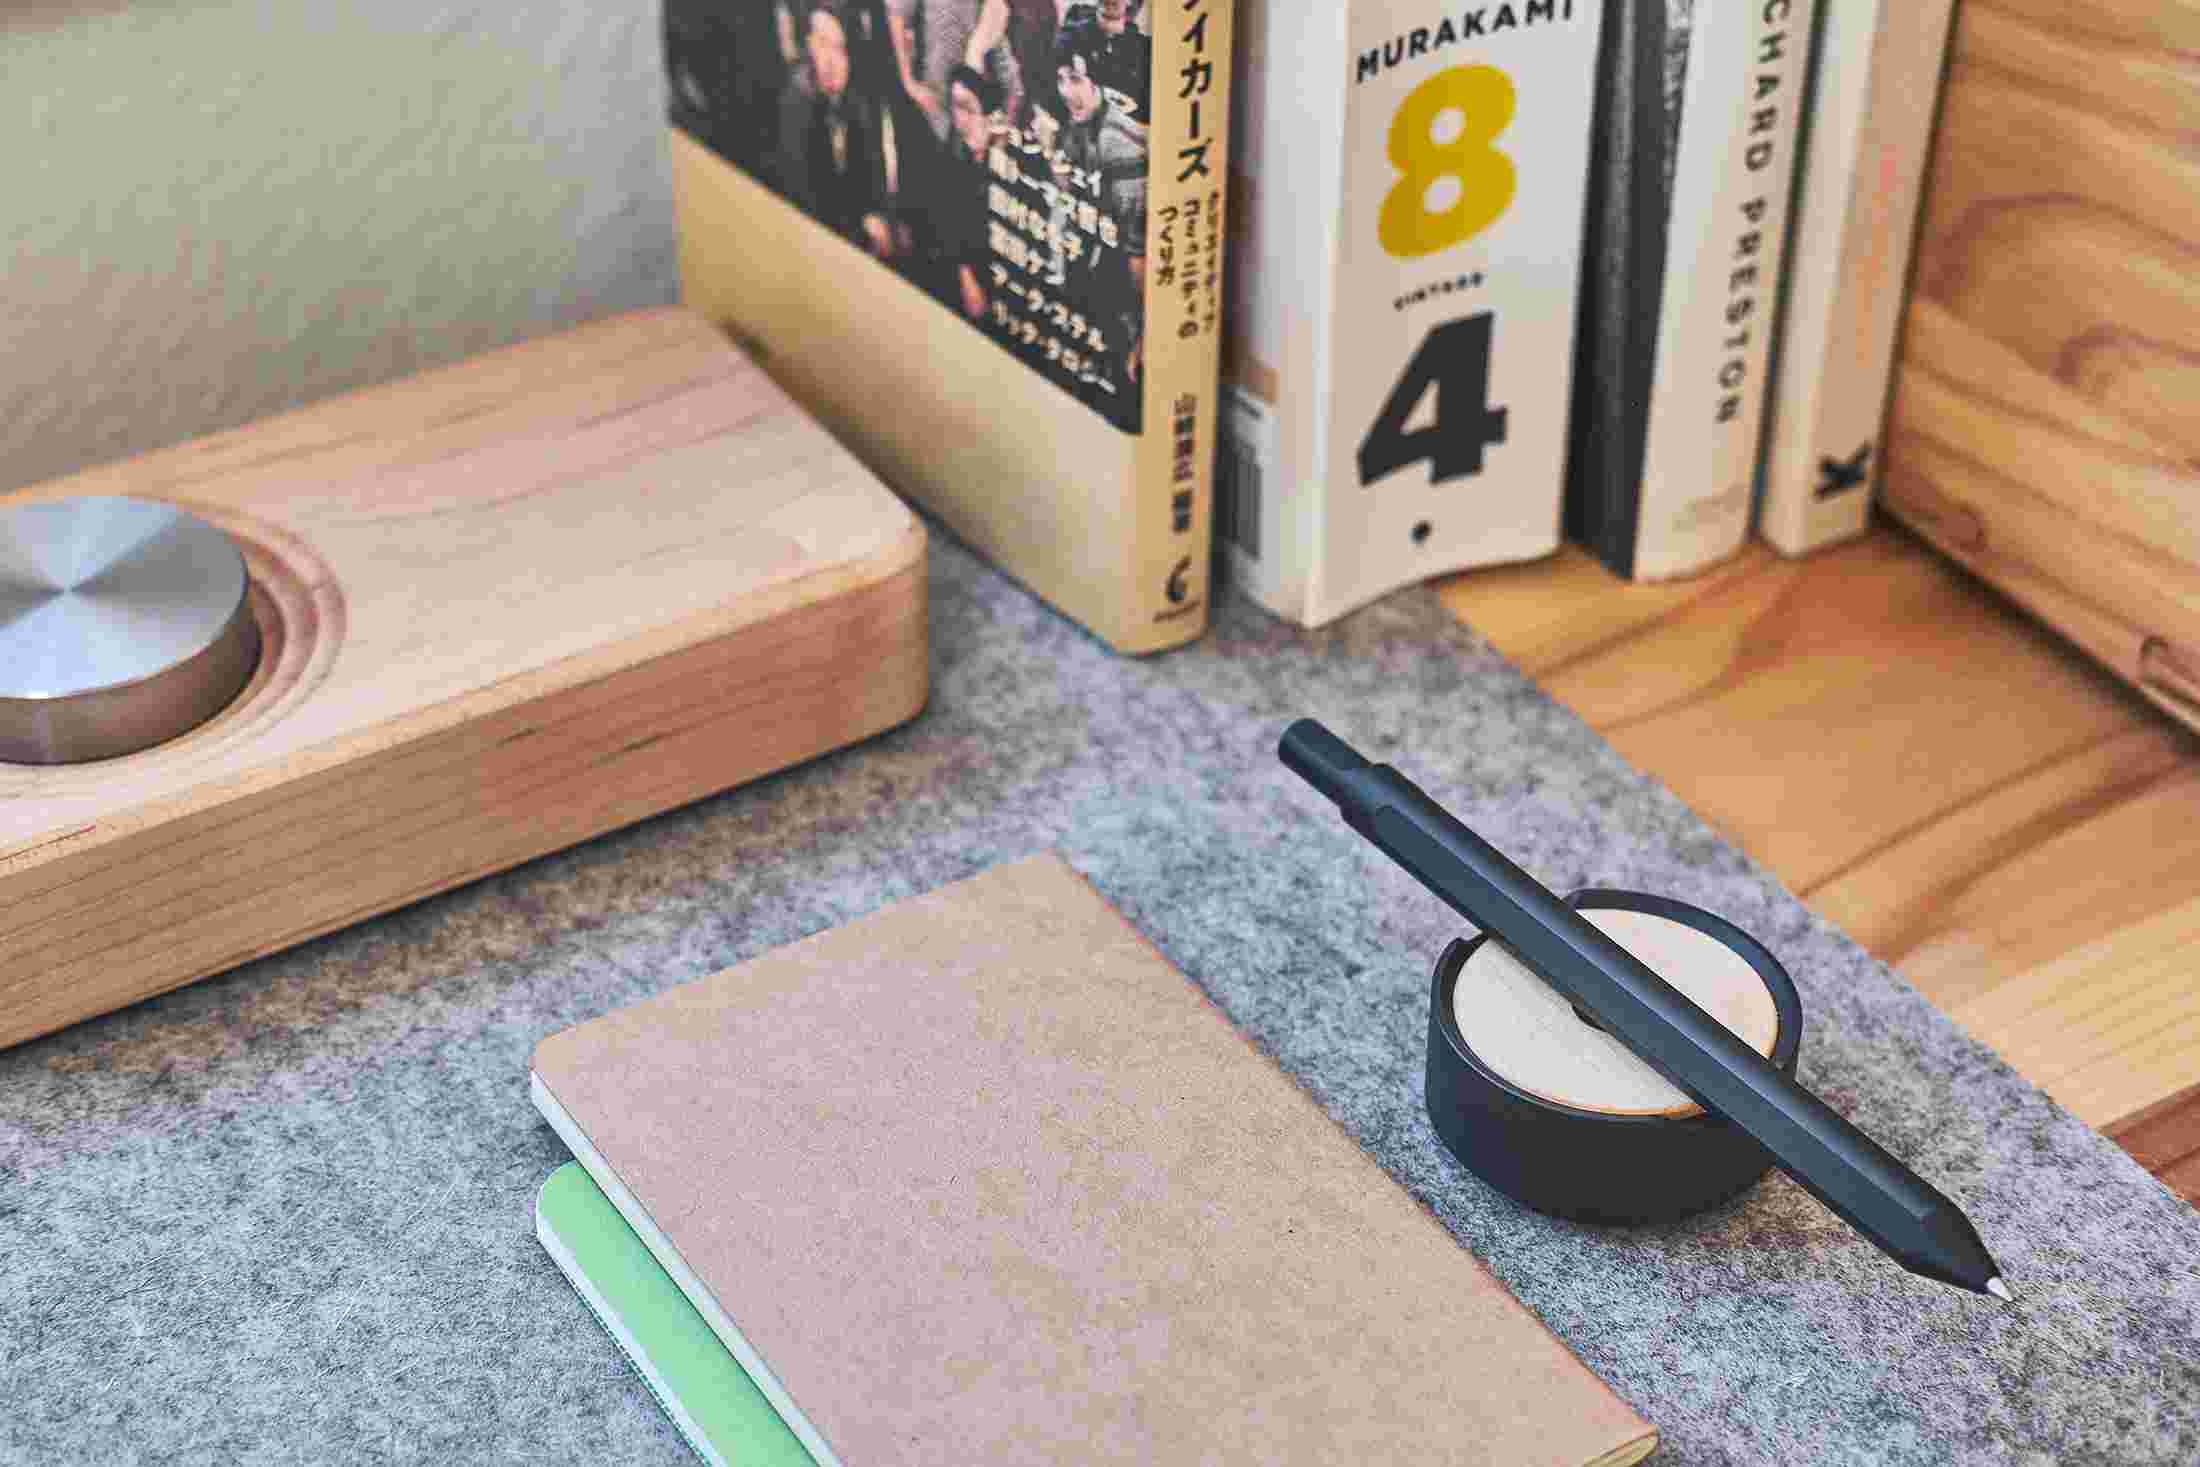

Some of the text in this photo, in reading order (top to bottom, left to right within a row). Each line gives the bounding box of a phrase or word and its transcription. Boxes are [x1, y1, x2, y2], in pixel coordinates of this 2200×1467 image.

[1177, 0, 1213, 183] イカーズ
[1356, 0, 1572, 84] MURAKAMI
[1377, 64, 1517, 258] 8
[1356, 310, 1508, 488] 4
[1715, 196, 1767, 424] PRESTON
